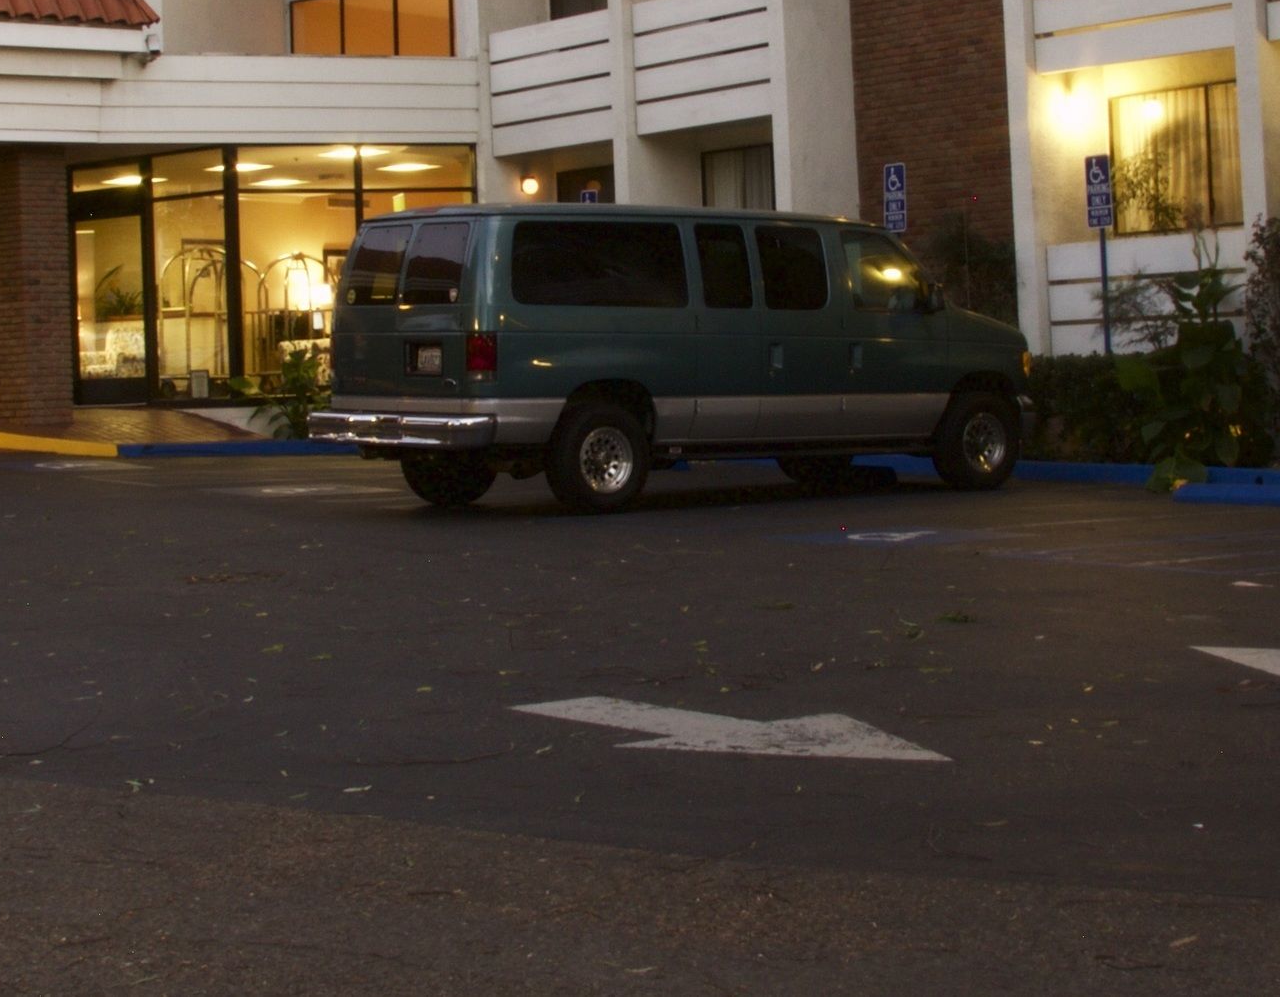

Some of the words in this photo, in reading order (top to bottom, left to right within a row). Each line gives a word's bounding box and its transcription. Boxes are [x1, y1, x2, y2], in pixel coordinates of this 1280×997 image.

[1087, 184, 1110, 195] PARKING
[885, 190, 905, 201] PARKING
[1090, 194, 1107, 206] ONLY
[888, 200, 902, 211] ONLY
